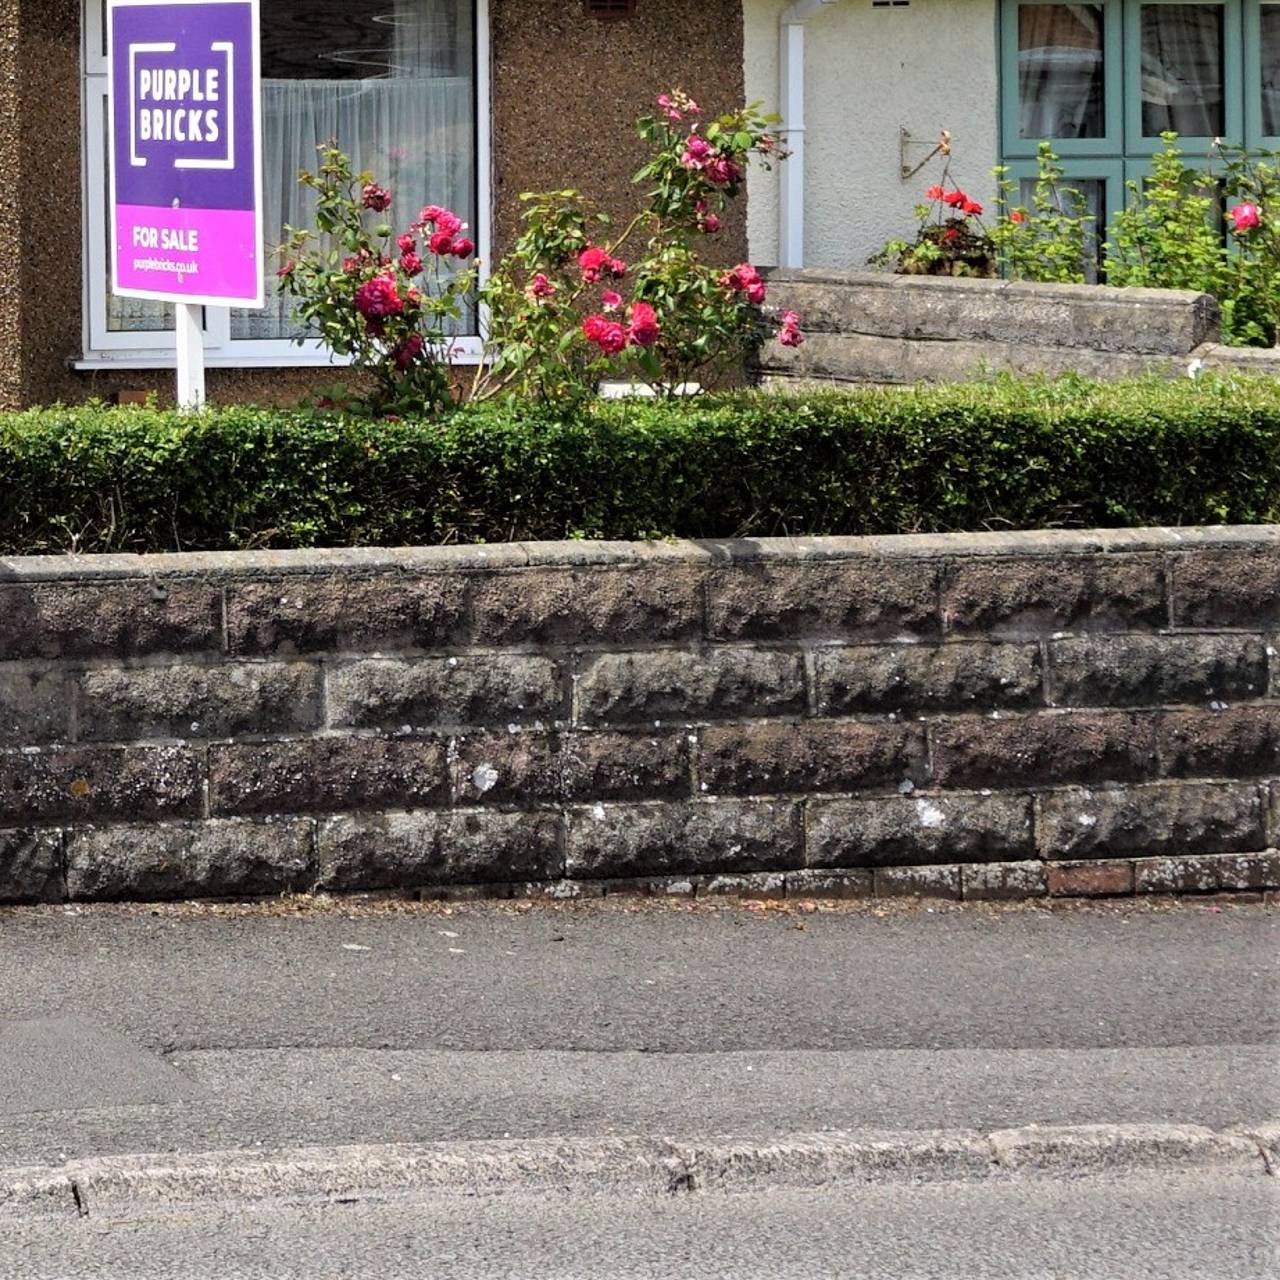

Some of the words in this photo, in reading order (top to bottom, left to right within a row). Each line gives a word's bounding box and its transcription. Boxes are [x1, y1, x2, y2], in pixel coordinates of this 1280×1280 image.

[140, 68, 219, 102] PURPLE
[140, 108, 219, 142] BRICKS
[132, 225, 159, 249] FOR
[161, 228, 200, 252] SALE
